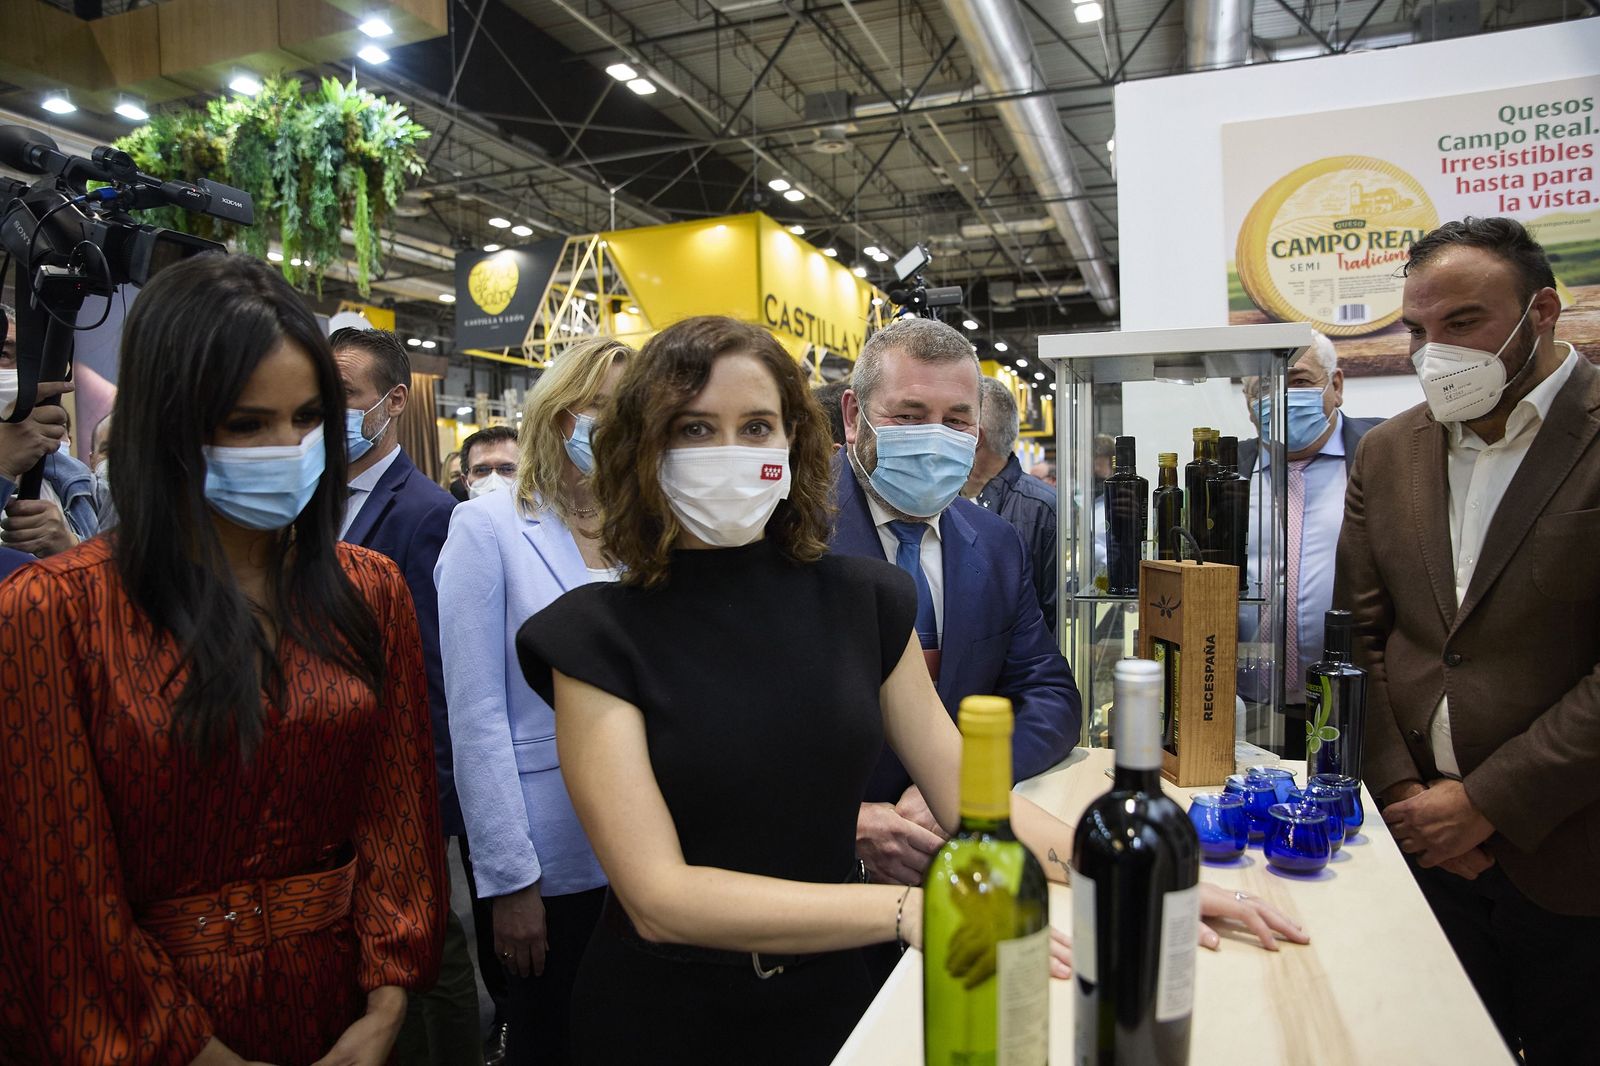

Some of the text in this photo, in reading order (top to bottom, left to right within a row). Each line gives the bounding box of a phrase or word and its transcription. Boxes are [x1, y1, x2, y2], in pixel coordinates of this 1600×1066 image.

[1498, 97, 1594, 125] Quesos
[1438, 116, 1599, 152] Campo Real.
[1441, 142, 1594, 174] Irresistibles
[1456, 166, 1593, 195] hasta para
[1499, 188, 1599, 213] la vista.
[13, 220, 31, 246] SONY
[1335, 220, 1364, 230] QUESO
[1271, 232, 1361, 259] CAMPO
[1290, 262, 1320, 272] SEMI
[464, 317, 498, 327] CASTILLA
[764, 293, 862, 358] CASTILLA Y
[1203, 633, 1216, 721] RECESPAÑA
